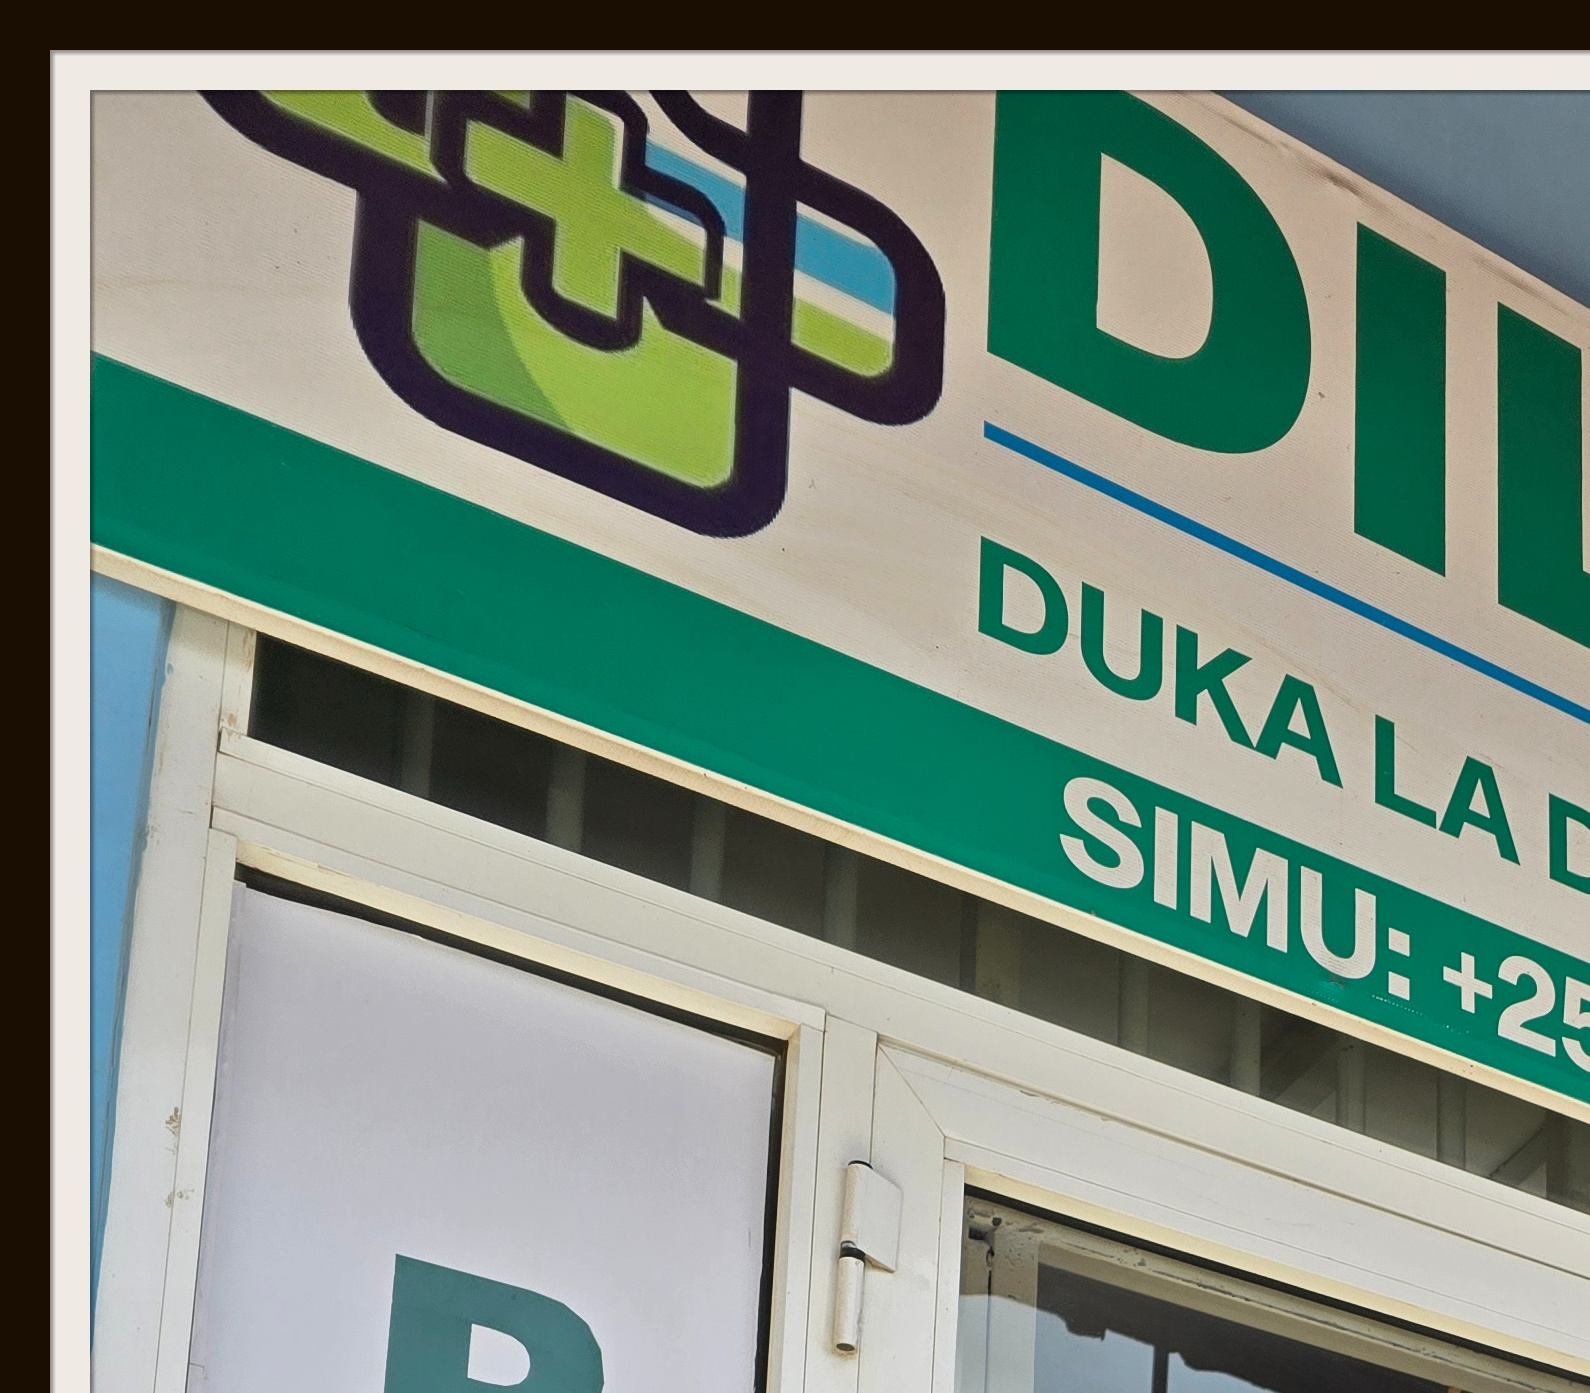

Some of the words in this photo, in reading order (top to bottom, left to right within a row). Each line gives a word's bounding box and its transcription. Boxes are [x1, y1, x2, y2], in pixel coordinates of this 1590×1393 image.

[978, 536, 1343, 789] DUKA
[1375, 715, 1520, 866] LA
[1059, 777, 1410, 1000] SIMU:
